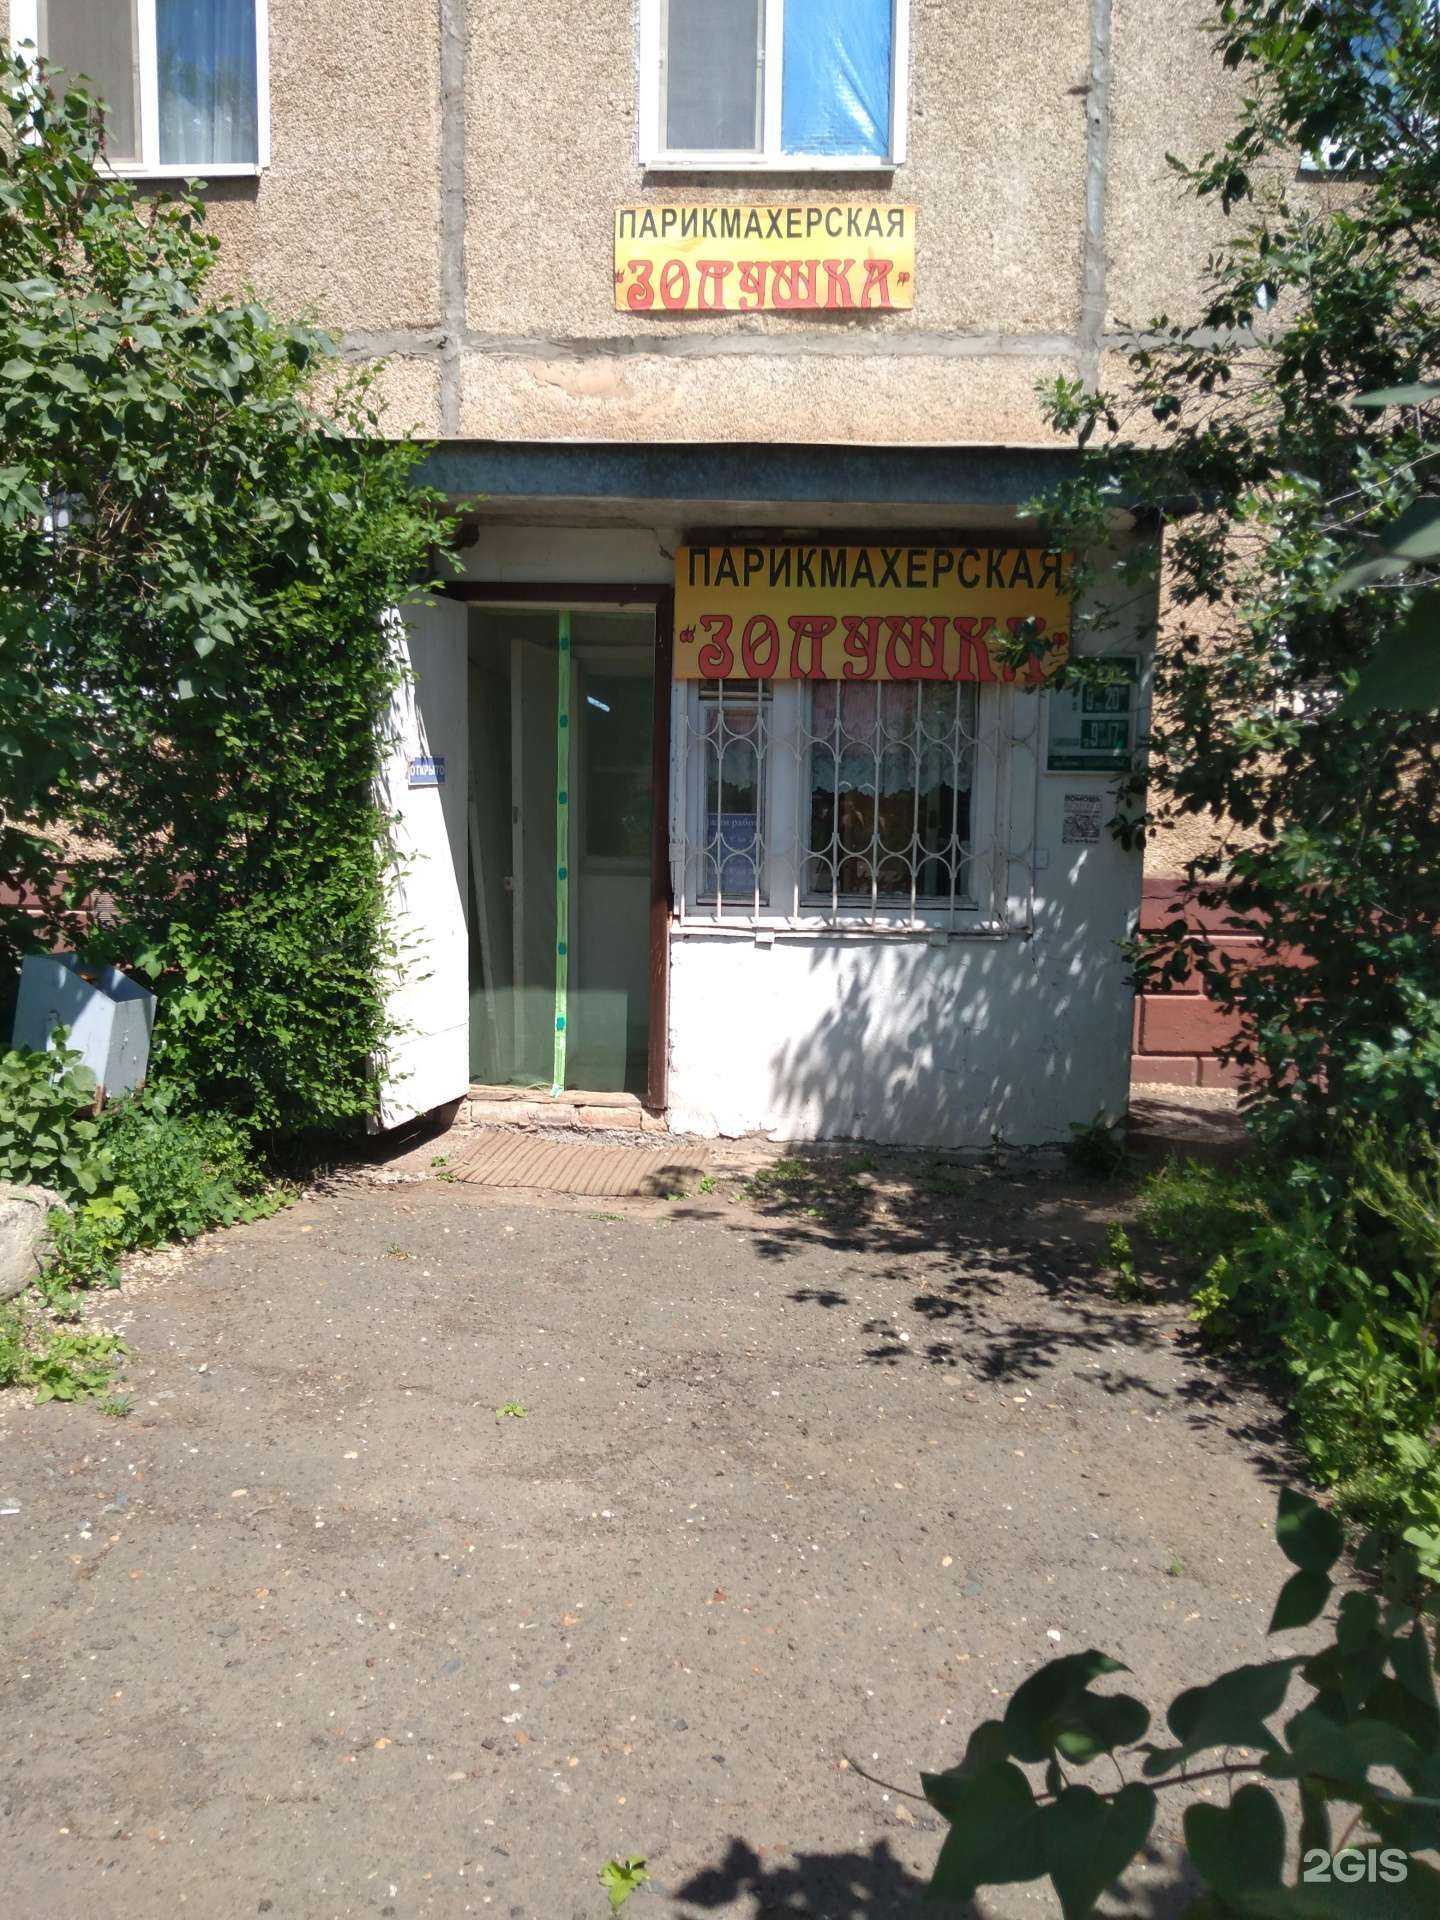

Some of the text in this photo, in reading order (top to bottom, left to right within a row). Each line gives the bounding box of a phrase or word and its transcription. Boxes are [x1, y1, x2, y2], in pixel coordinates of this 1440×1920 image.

[618, 207, 905, 239] ПАРИКМАХЕРСКАЯ
[688, 547, 1063, 589] ПАРИКМАХЕРСКАЯ
[410, 763, 445, 777] ОТКРЫТО
